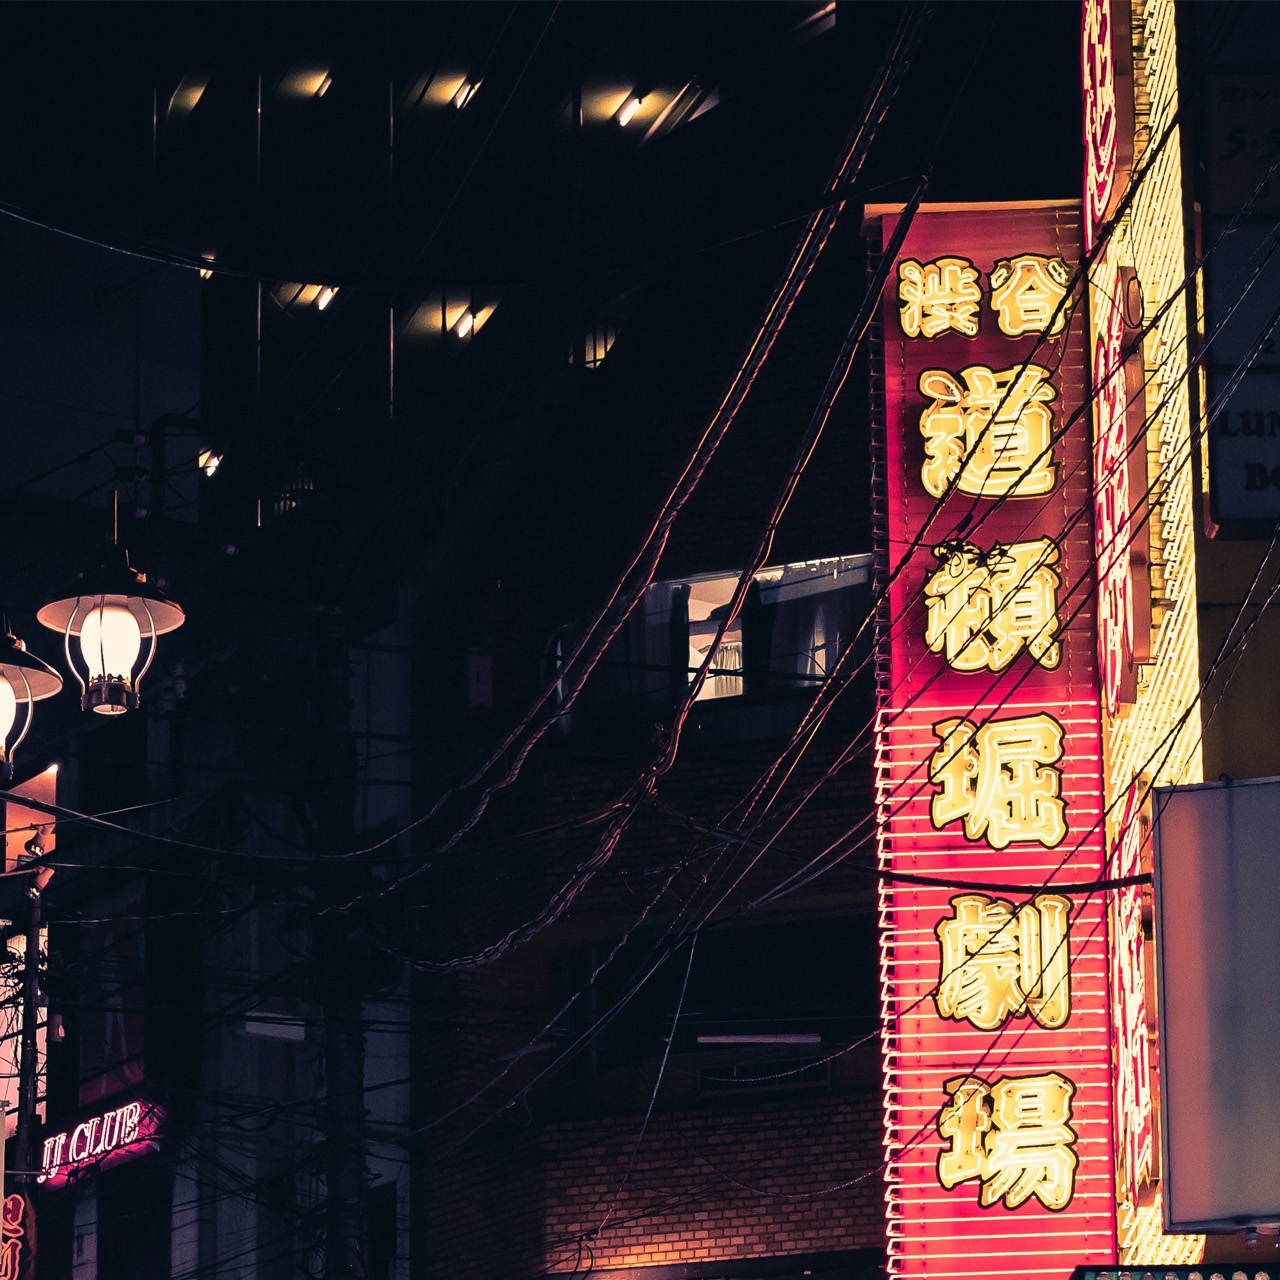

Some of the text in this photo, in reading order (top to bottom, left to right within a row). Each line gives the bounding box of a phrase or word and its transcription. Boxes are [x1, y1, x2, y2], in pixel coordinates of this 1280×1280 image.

[897, 255, 1075, 340] 渋谷
[918, 364, 1078, 1211] 道頓堀劇場
[68, 1101, 141, 1161] CLUB
